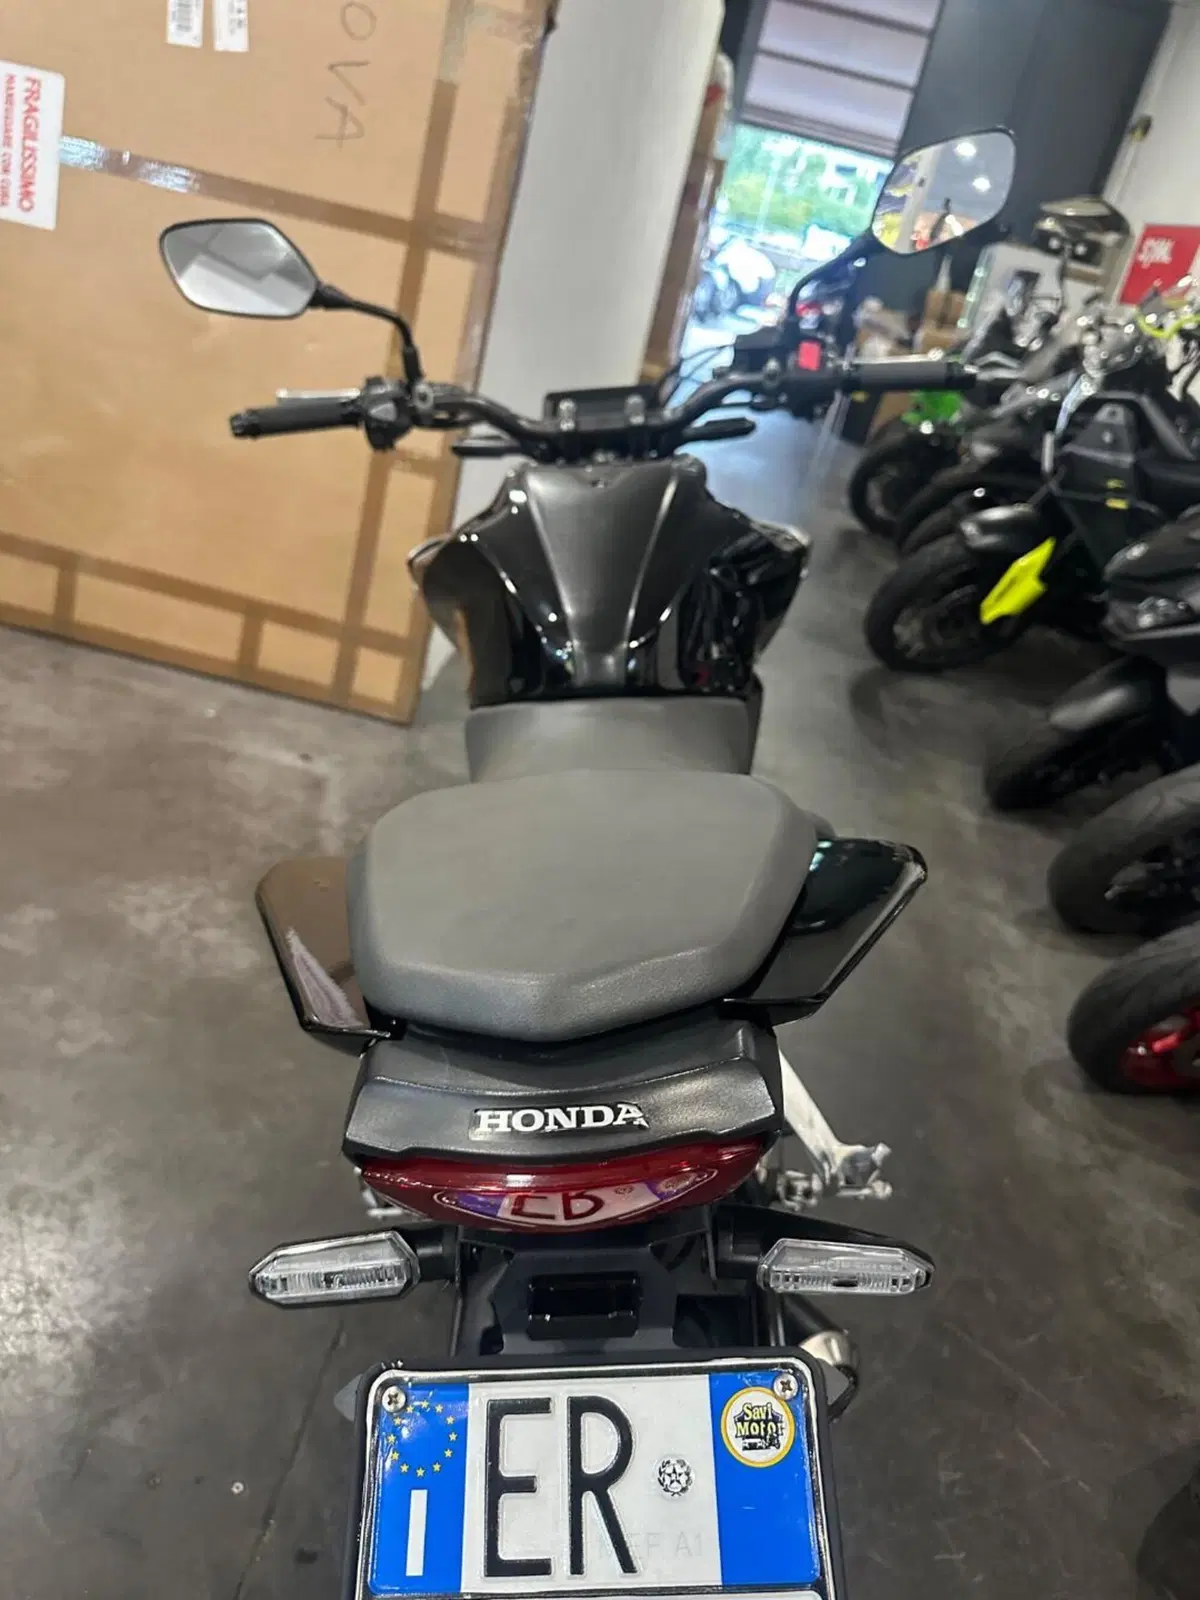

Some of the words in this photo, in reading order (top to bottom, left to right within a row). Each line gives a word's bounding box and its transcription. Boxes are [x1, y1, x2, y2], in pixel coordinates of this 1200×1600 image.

[19, 75, 42, 212] FRAGILISSIMO
[475, 1103, 649, 1133] HONDA
[406, 1489, 428, 1576] I
[484, 1395, 638, 1577] ER
